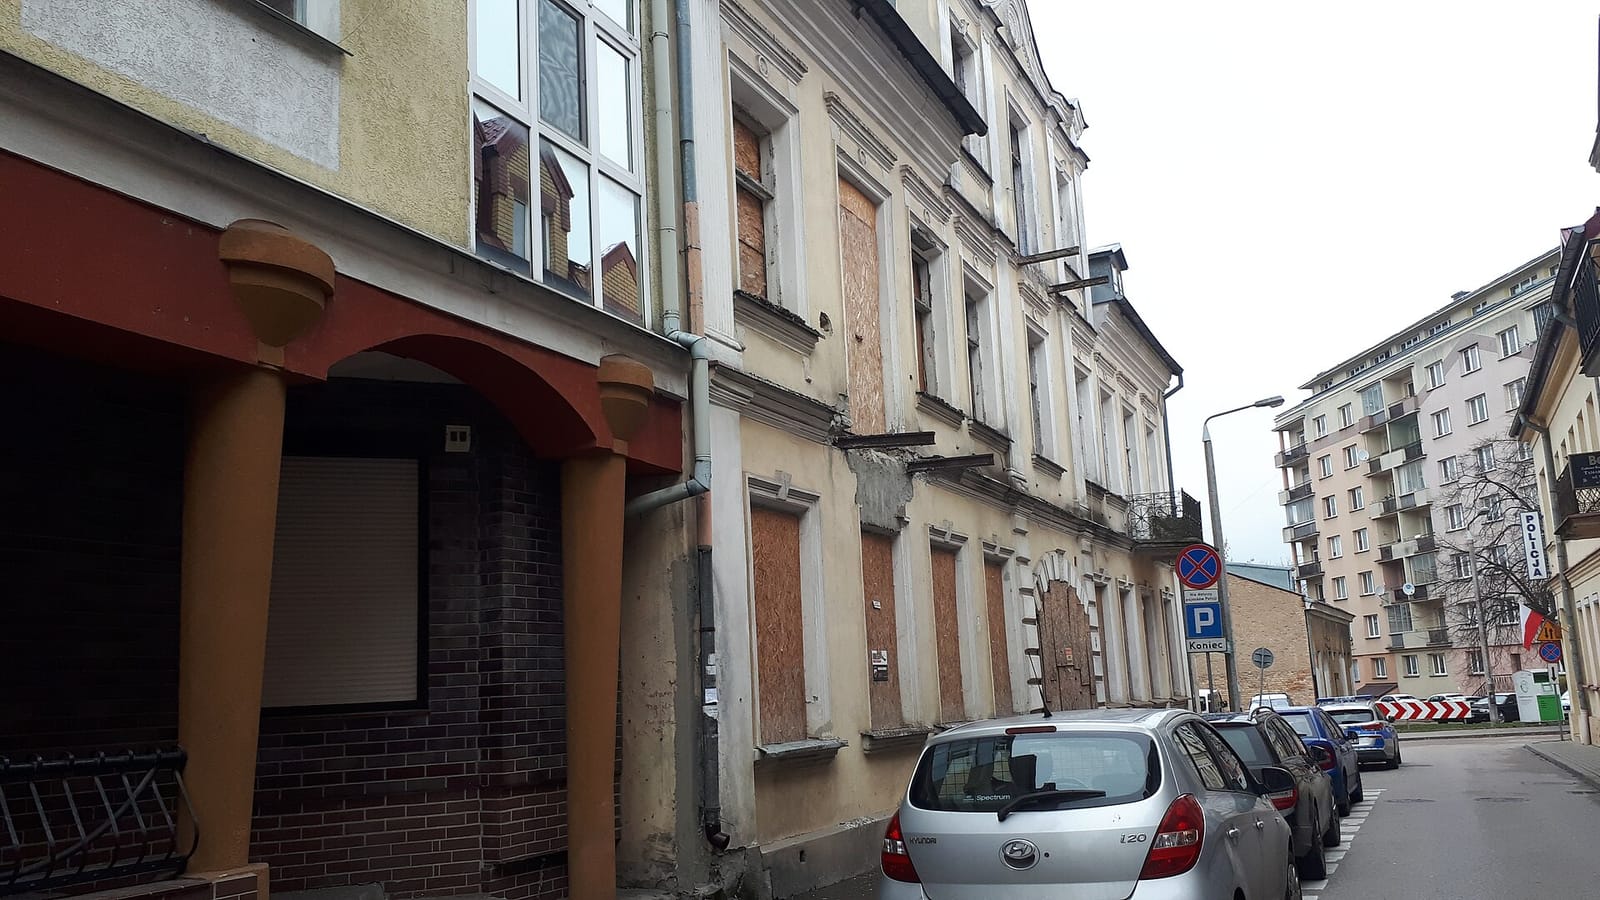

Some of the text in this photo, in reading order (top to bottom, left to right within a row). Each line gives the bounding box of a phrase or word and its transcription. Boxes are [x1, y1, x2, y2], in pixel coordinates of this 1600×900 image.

[1525, 515, 1542, 577] POLICJA
[1193, 607, 1214, 633] P
[1189, 641, 1223, 650] Koniec
[976, 794, 1011, 802] Spectrum
[1120, 833, 1147, 843] i20
